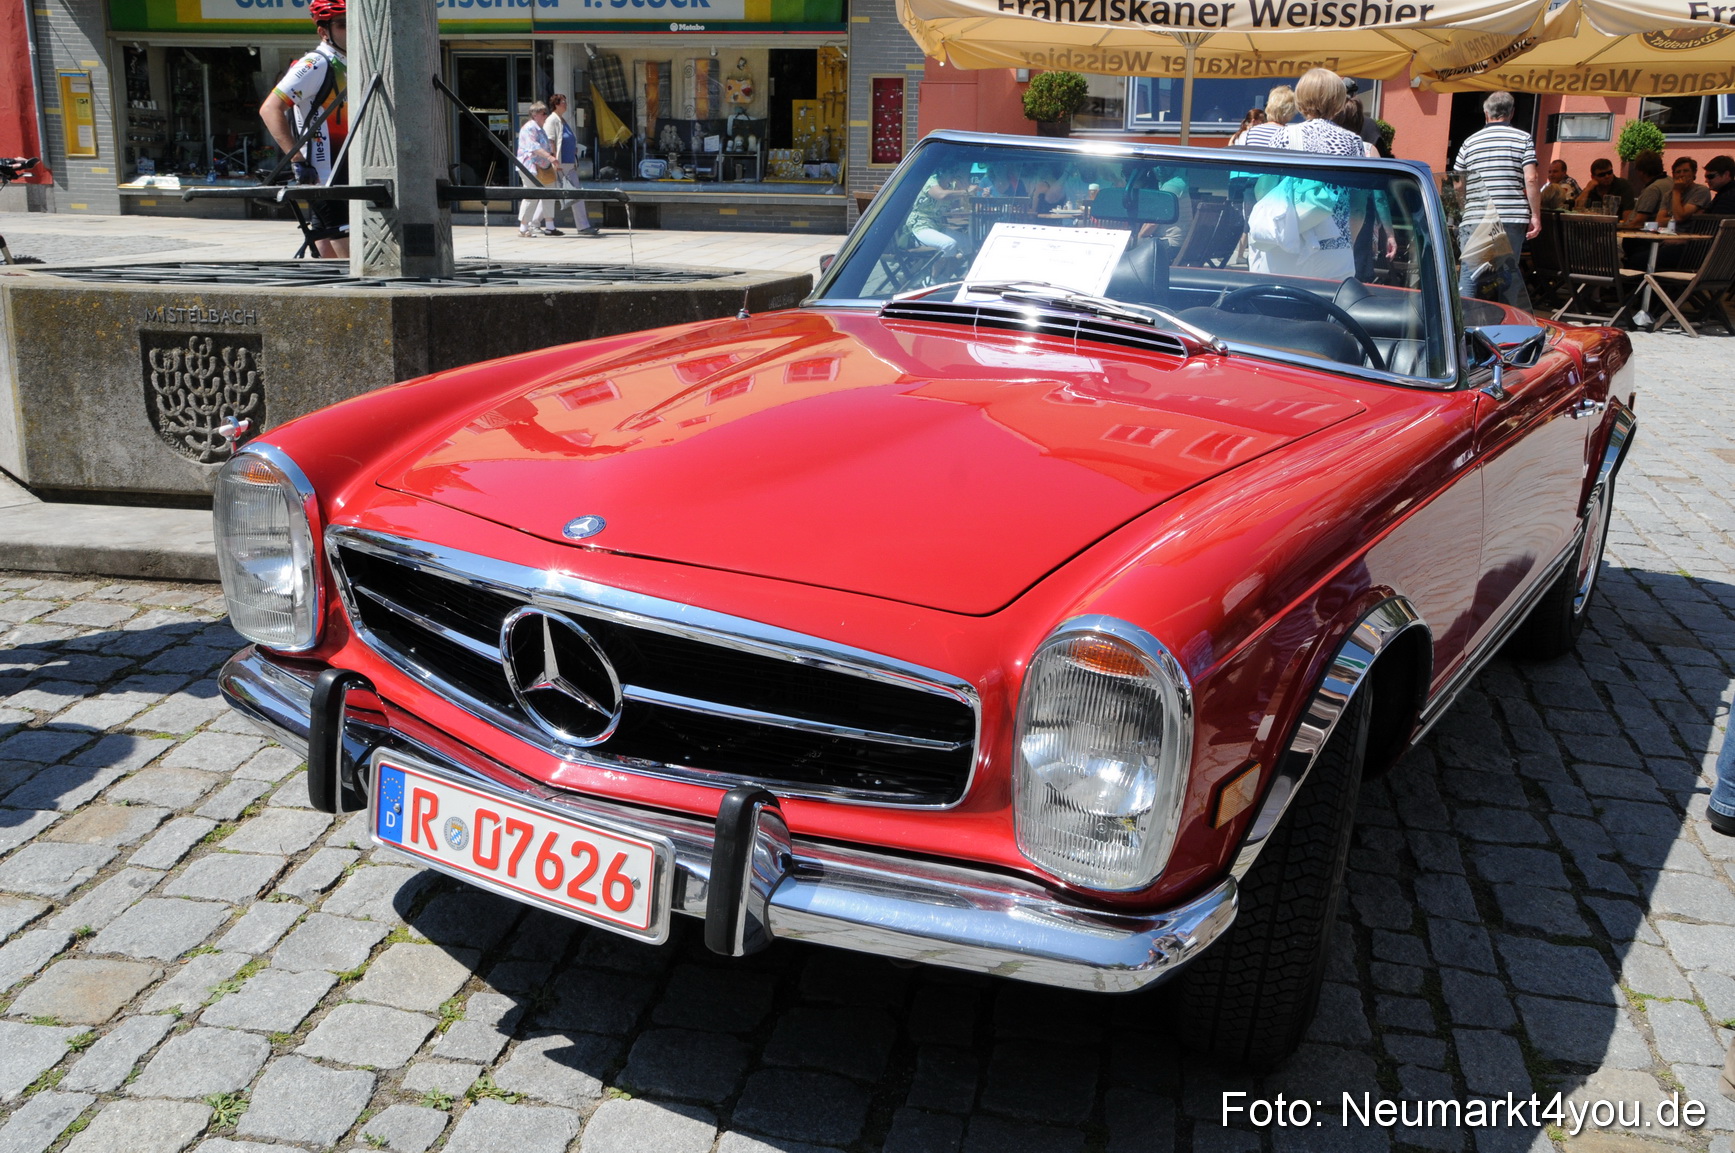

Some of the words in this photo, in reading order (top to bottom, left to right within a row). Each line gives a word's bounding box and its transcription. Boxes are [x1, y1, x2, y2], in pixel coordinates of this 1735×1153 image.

[1249, 0, 1434, 28] Weissbier
[679, 23, 705, 31] Metabo
[144, 305, 257, 325] MISTELBACH
[385, 811, 396, 828] D
[410, 787, 438, 851] R
[472, 807, 634, 912] 07626
